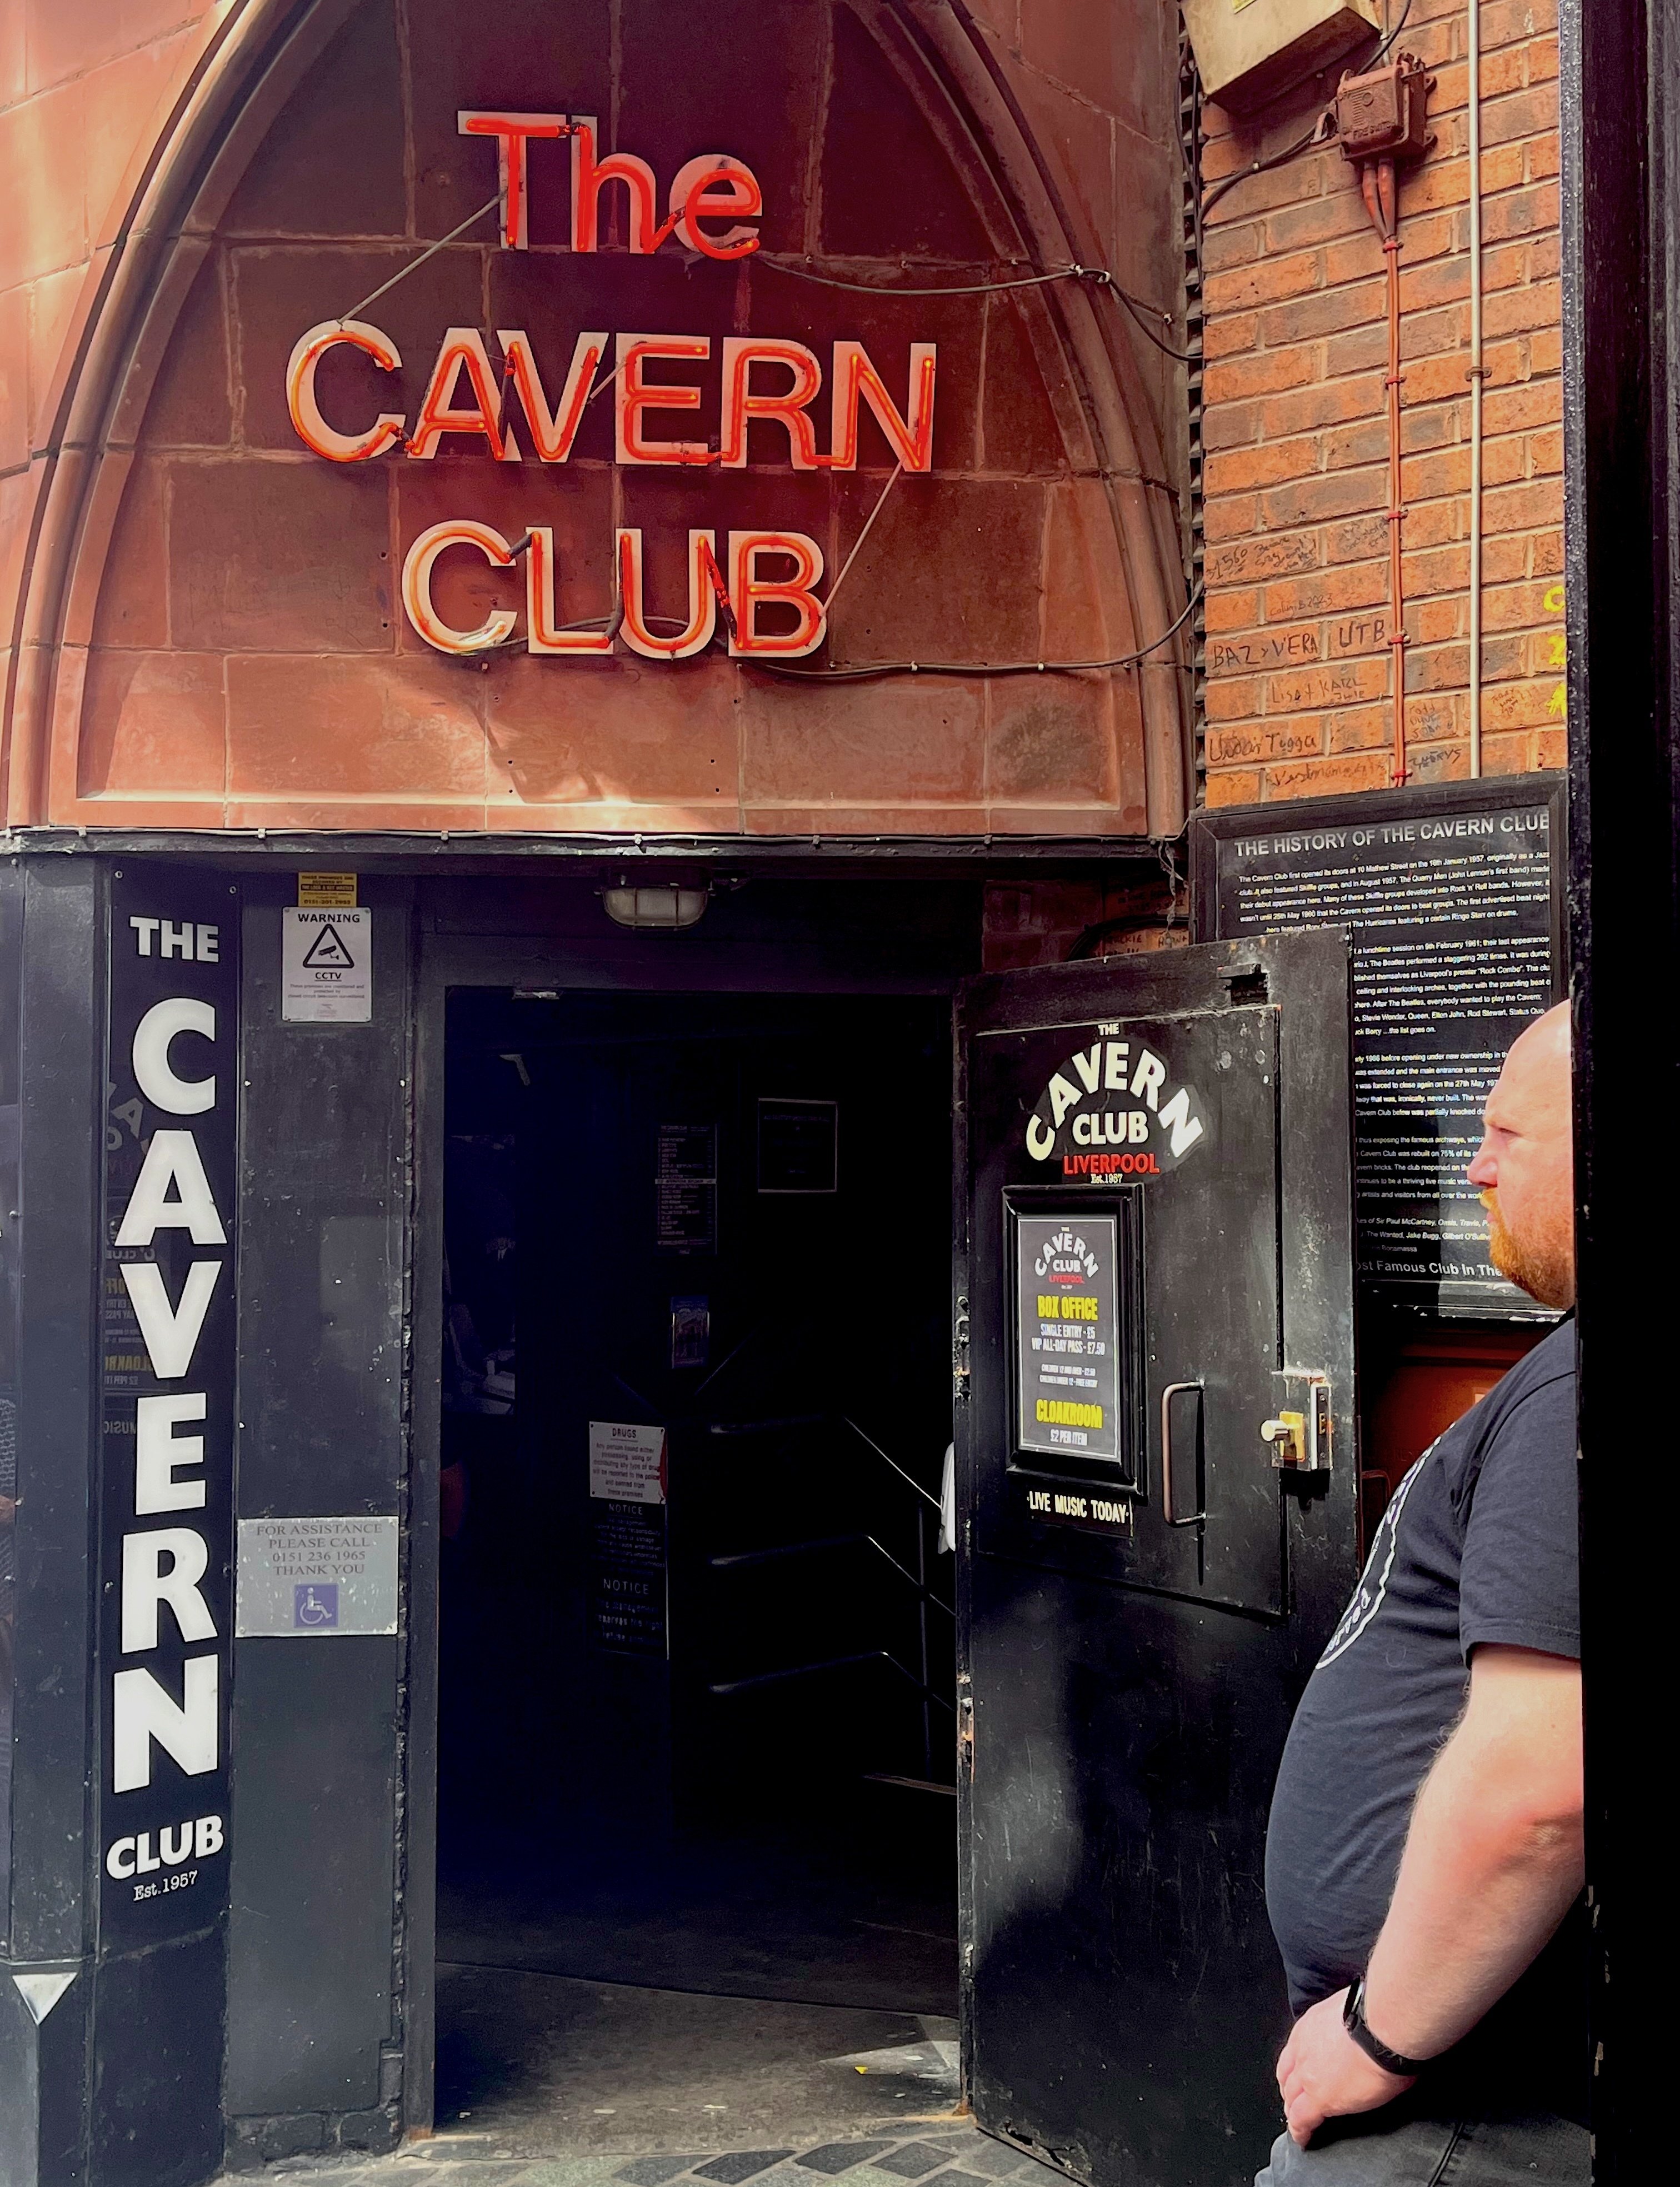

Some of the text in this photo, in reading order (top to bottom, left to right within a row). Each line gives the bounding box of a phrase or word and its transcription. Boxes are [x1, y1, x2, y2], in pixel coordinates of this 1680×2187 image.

[457, 109, 762, 260] The
[285, 319, 937, 473] CAVERN
[401, 519, 828, 659] CLUB
[1339, 620, 1385, 648] UTB
[1234, 840, 1269, 856] THE
[1274, 832, 1347, 853] HISTORY
[1353, 830, 1375, 846] OF
[1381, 826, 1415, 843] THE
[1421, 818, 1493, 839] CAVERN
[1487, 853, 1517, 862] originally
[298, 913, 360, 922] WARNING
[129, 916, 219, 963] THE
[1098, 1023, 1119, 1036] THE
[1026, 1042, 1203, 1160] CAVERN
[1072, 1111, 1148, 1145] CLUB
[1062, 1153, 1160, 1175] LIVERPOOL
[1035, 1233, 1099, 1277] CAVERN
[1053, 1260, 1081, 1272] CLUB
[1377, 1261, 1426, 1272] Famous
[1429, 1263, 1459, 1275] Club
[1462, 1264, 1476, 1275] In
[1037, 1295, 1098, 1320] BOX OFFICE
[1031, 1337, 1042, 1350] VIP
[114, 997, 227, 1793] CAVERN
[1036, 1399, 1103, 1429] CLOAKROOM
[612, 1428, 636, 1438] DRUGS
[609, 1503, 643, 1515] NOTICE
[1029, 1491, 1127, 1524] LIVE MUSIC TODAY
[257, 1524, 383, 1535] FOR ASSISTANCE
[269, 1537, 371, 1549] PLEASE CALL
[272, 1551, 366, 1562] 0151 236 1965
[274, 1564, 365, 1575] THANK YOU
[603, 1578, 649, 1595] NOTICE
[107, 1815, 224, 1880] CLUB
[133, 1870, 198, 1901] Est.1957
